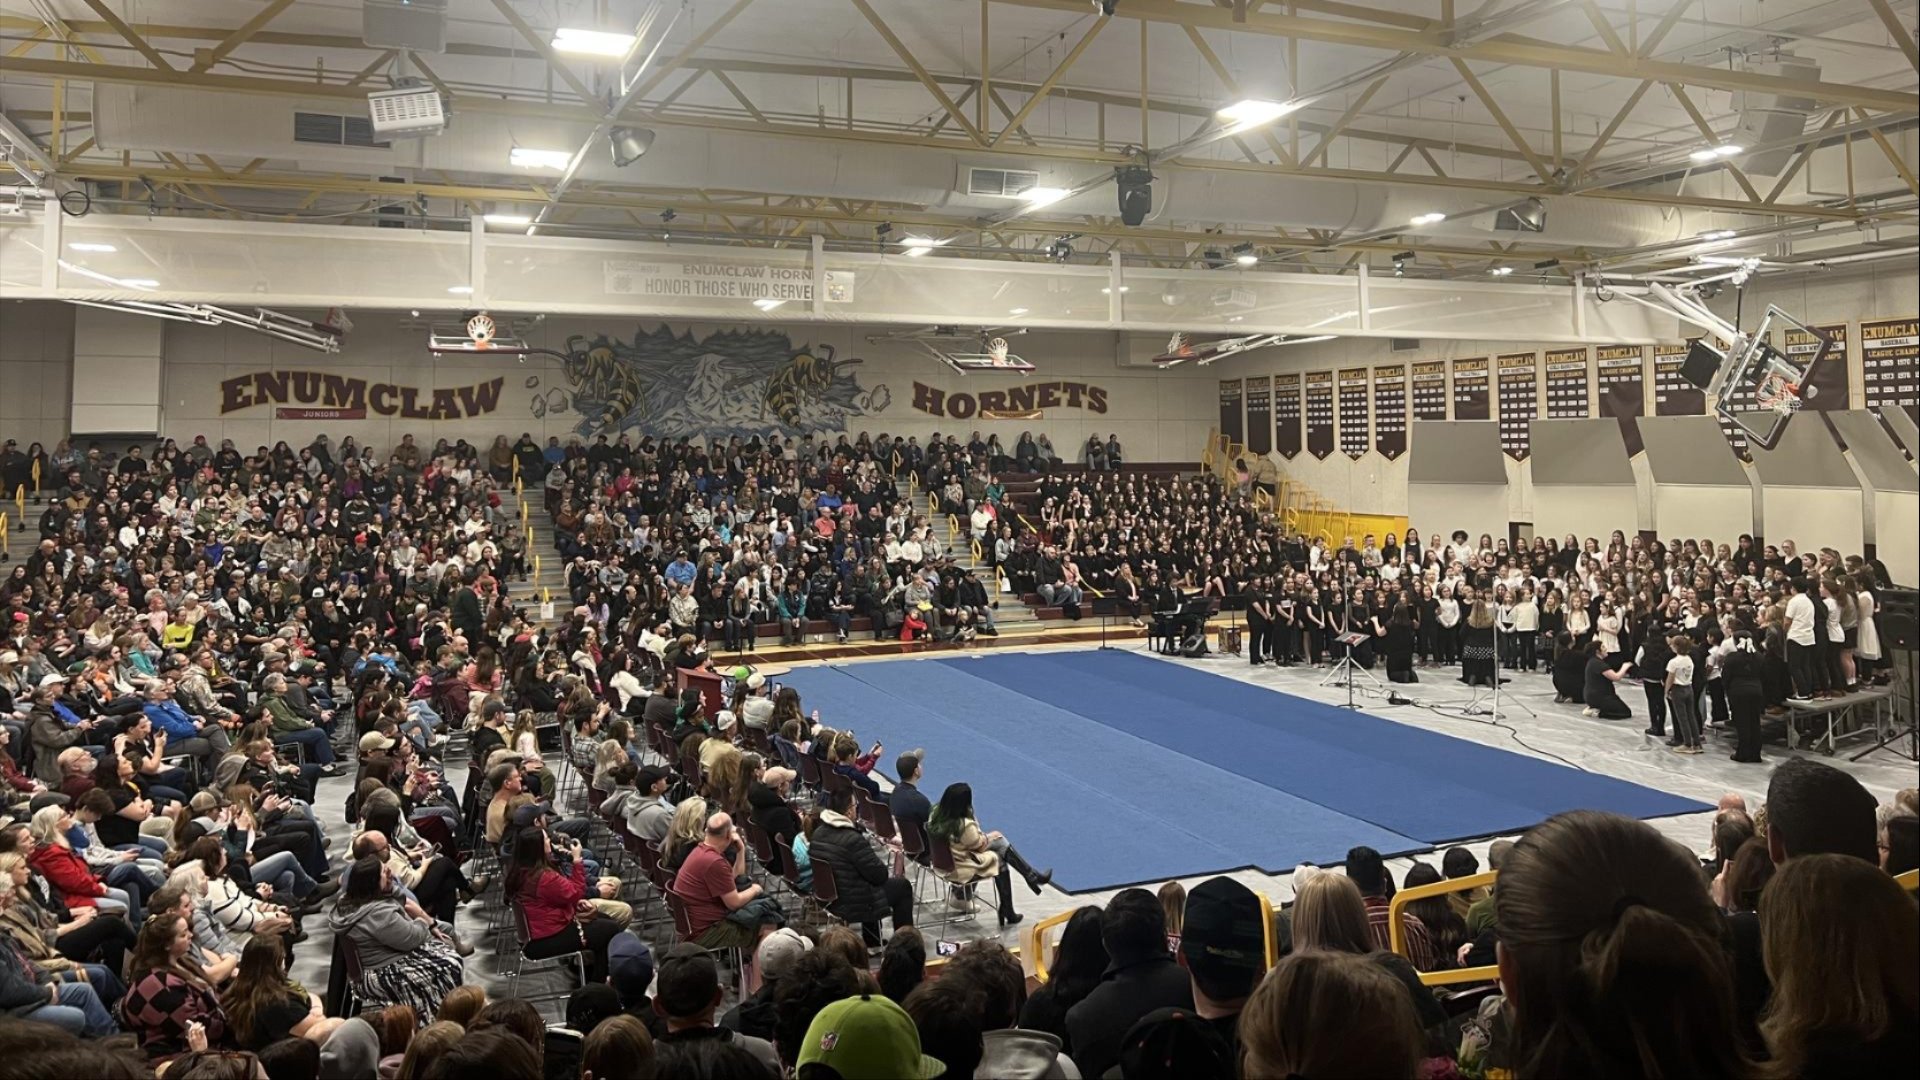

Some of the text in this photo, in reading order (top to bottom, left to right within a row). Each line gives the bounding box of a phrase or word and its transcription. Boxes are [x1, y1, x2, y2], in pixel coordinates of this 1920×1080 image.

[683, 264, 833, 281] ENUMCLAW HORNS
[645, 279, 691, 294] HONOR
[694, 280, 736, 296] THOSE
[740, 282, 769, 298] WHO
[1863, 323, 1919, 339] ENUMCLA
[1881, 338, 1909, 346] BASEBALL
[1598, 347, 1640, 359] ENUMCLAW
[1895, 347, 1919, 356] CHAMP
[220, 370, 504, 420] ENUMCLAW
[912, 380, 1108, 419] HORNETS
[303, 410, 340, 418] JUNIORS
